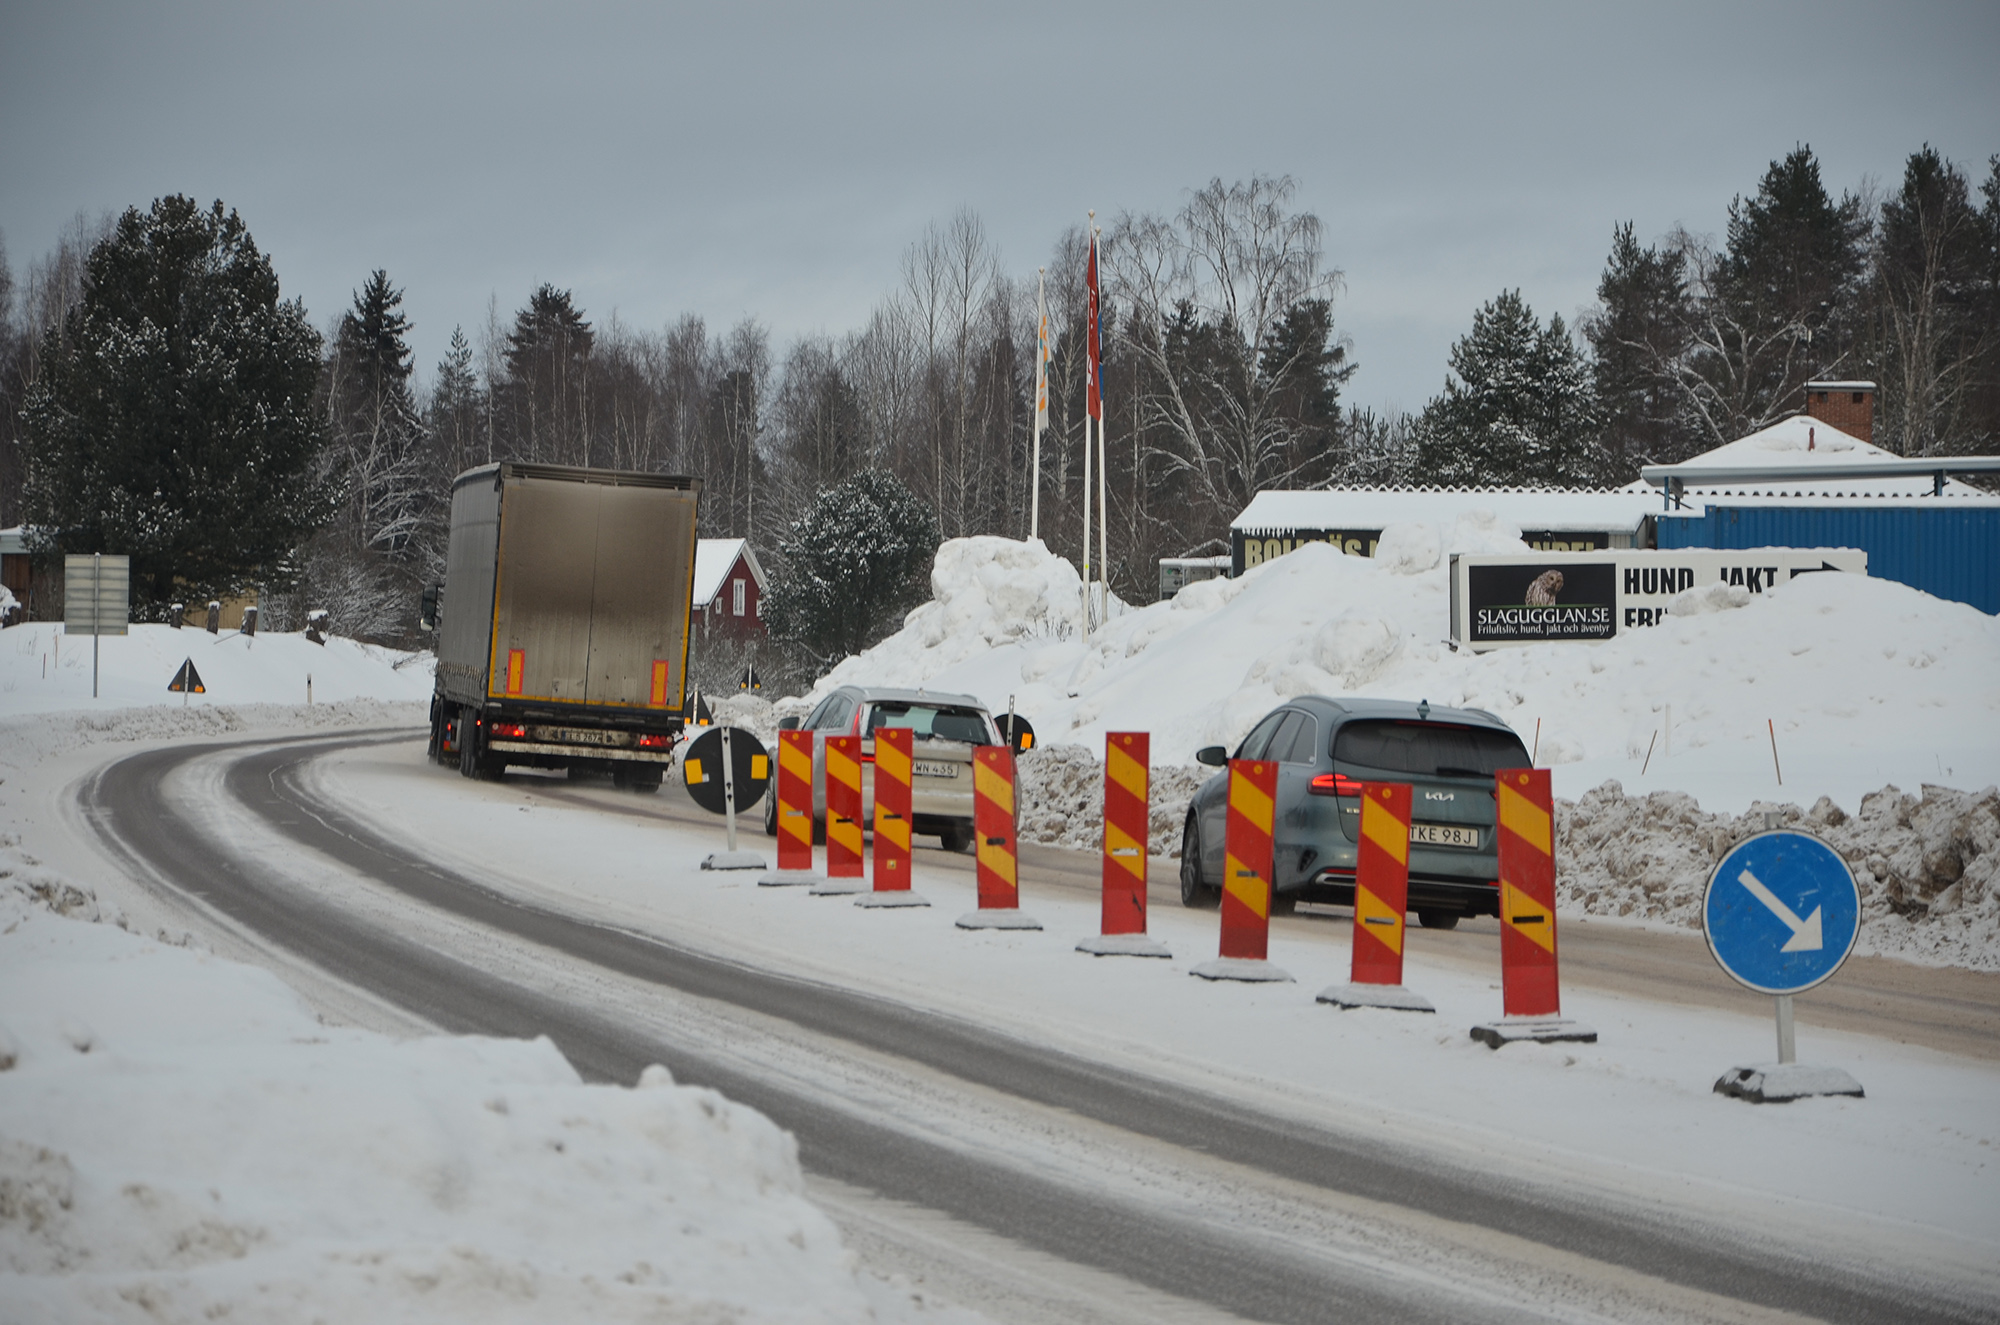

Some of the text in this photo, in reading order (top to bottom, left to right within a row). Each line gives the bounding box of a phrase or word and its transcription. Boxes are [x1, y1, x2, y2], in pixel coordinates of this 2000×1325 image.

[1624, 568, 1694, 594] HUND
[1477, 607, 1610, 624] SLAGUGGLAN.SE
[1624, 608, 1668, 627] FRI
[1478, 623, 1610, 636] Friluftsliv, hund, jakt och äventyr
[912, 762, 930, 773] WN
[1425, 791, 1455, 801] KIA
[1410, 826, 1472, 844] TKE 98J
